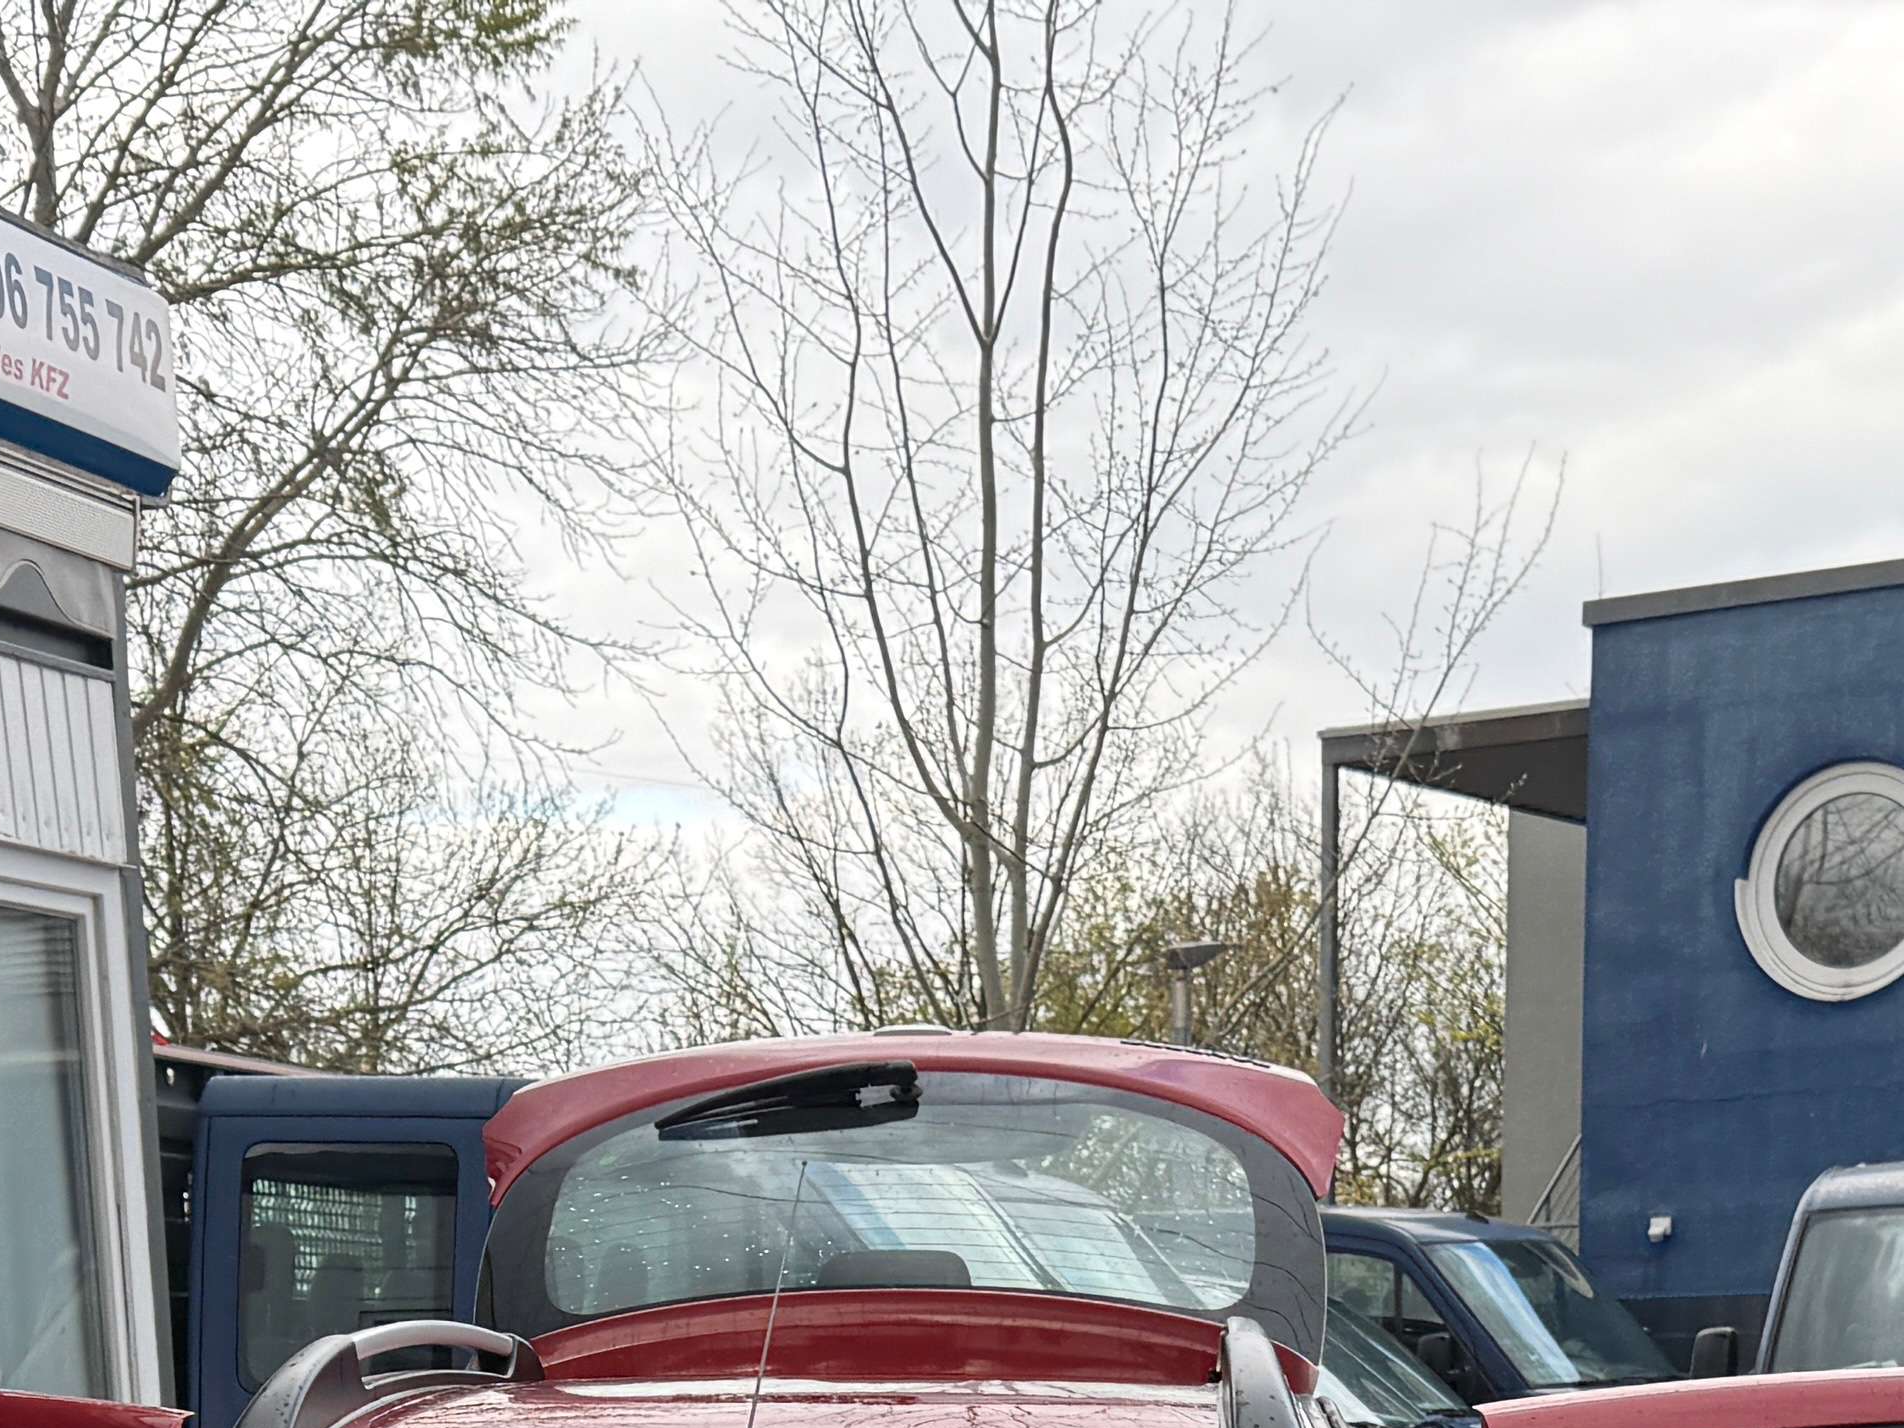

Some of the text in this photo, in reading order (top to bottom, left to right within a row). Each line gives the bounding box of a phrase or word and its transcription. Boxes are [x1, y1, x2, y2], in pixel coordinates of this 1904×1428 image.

[34, 264, 100, 362] 755
[105, 298, 167, 393] 742
[31, 357, 70, 400] KFZ
